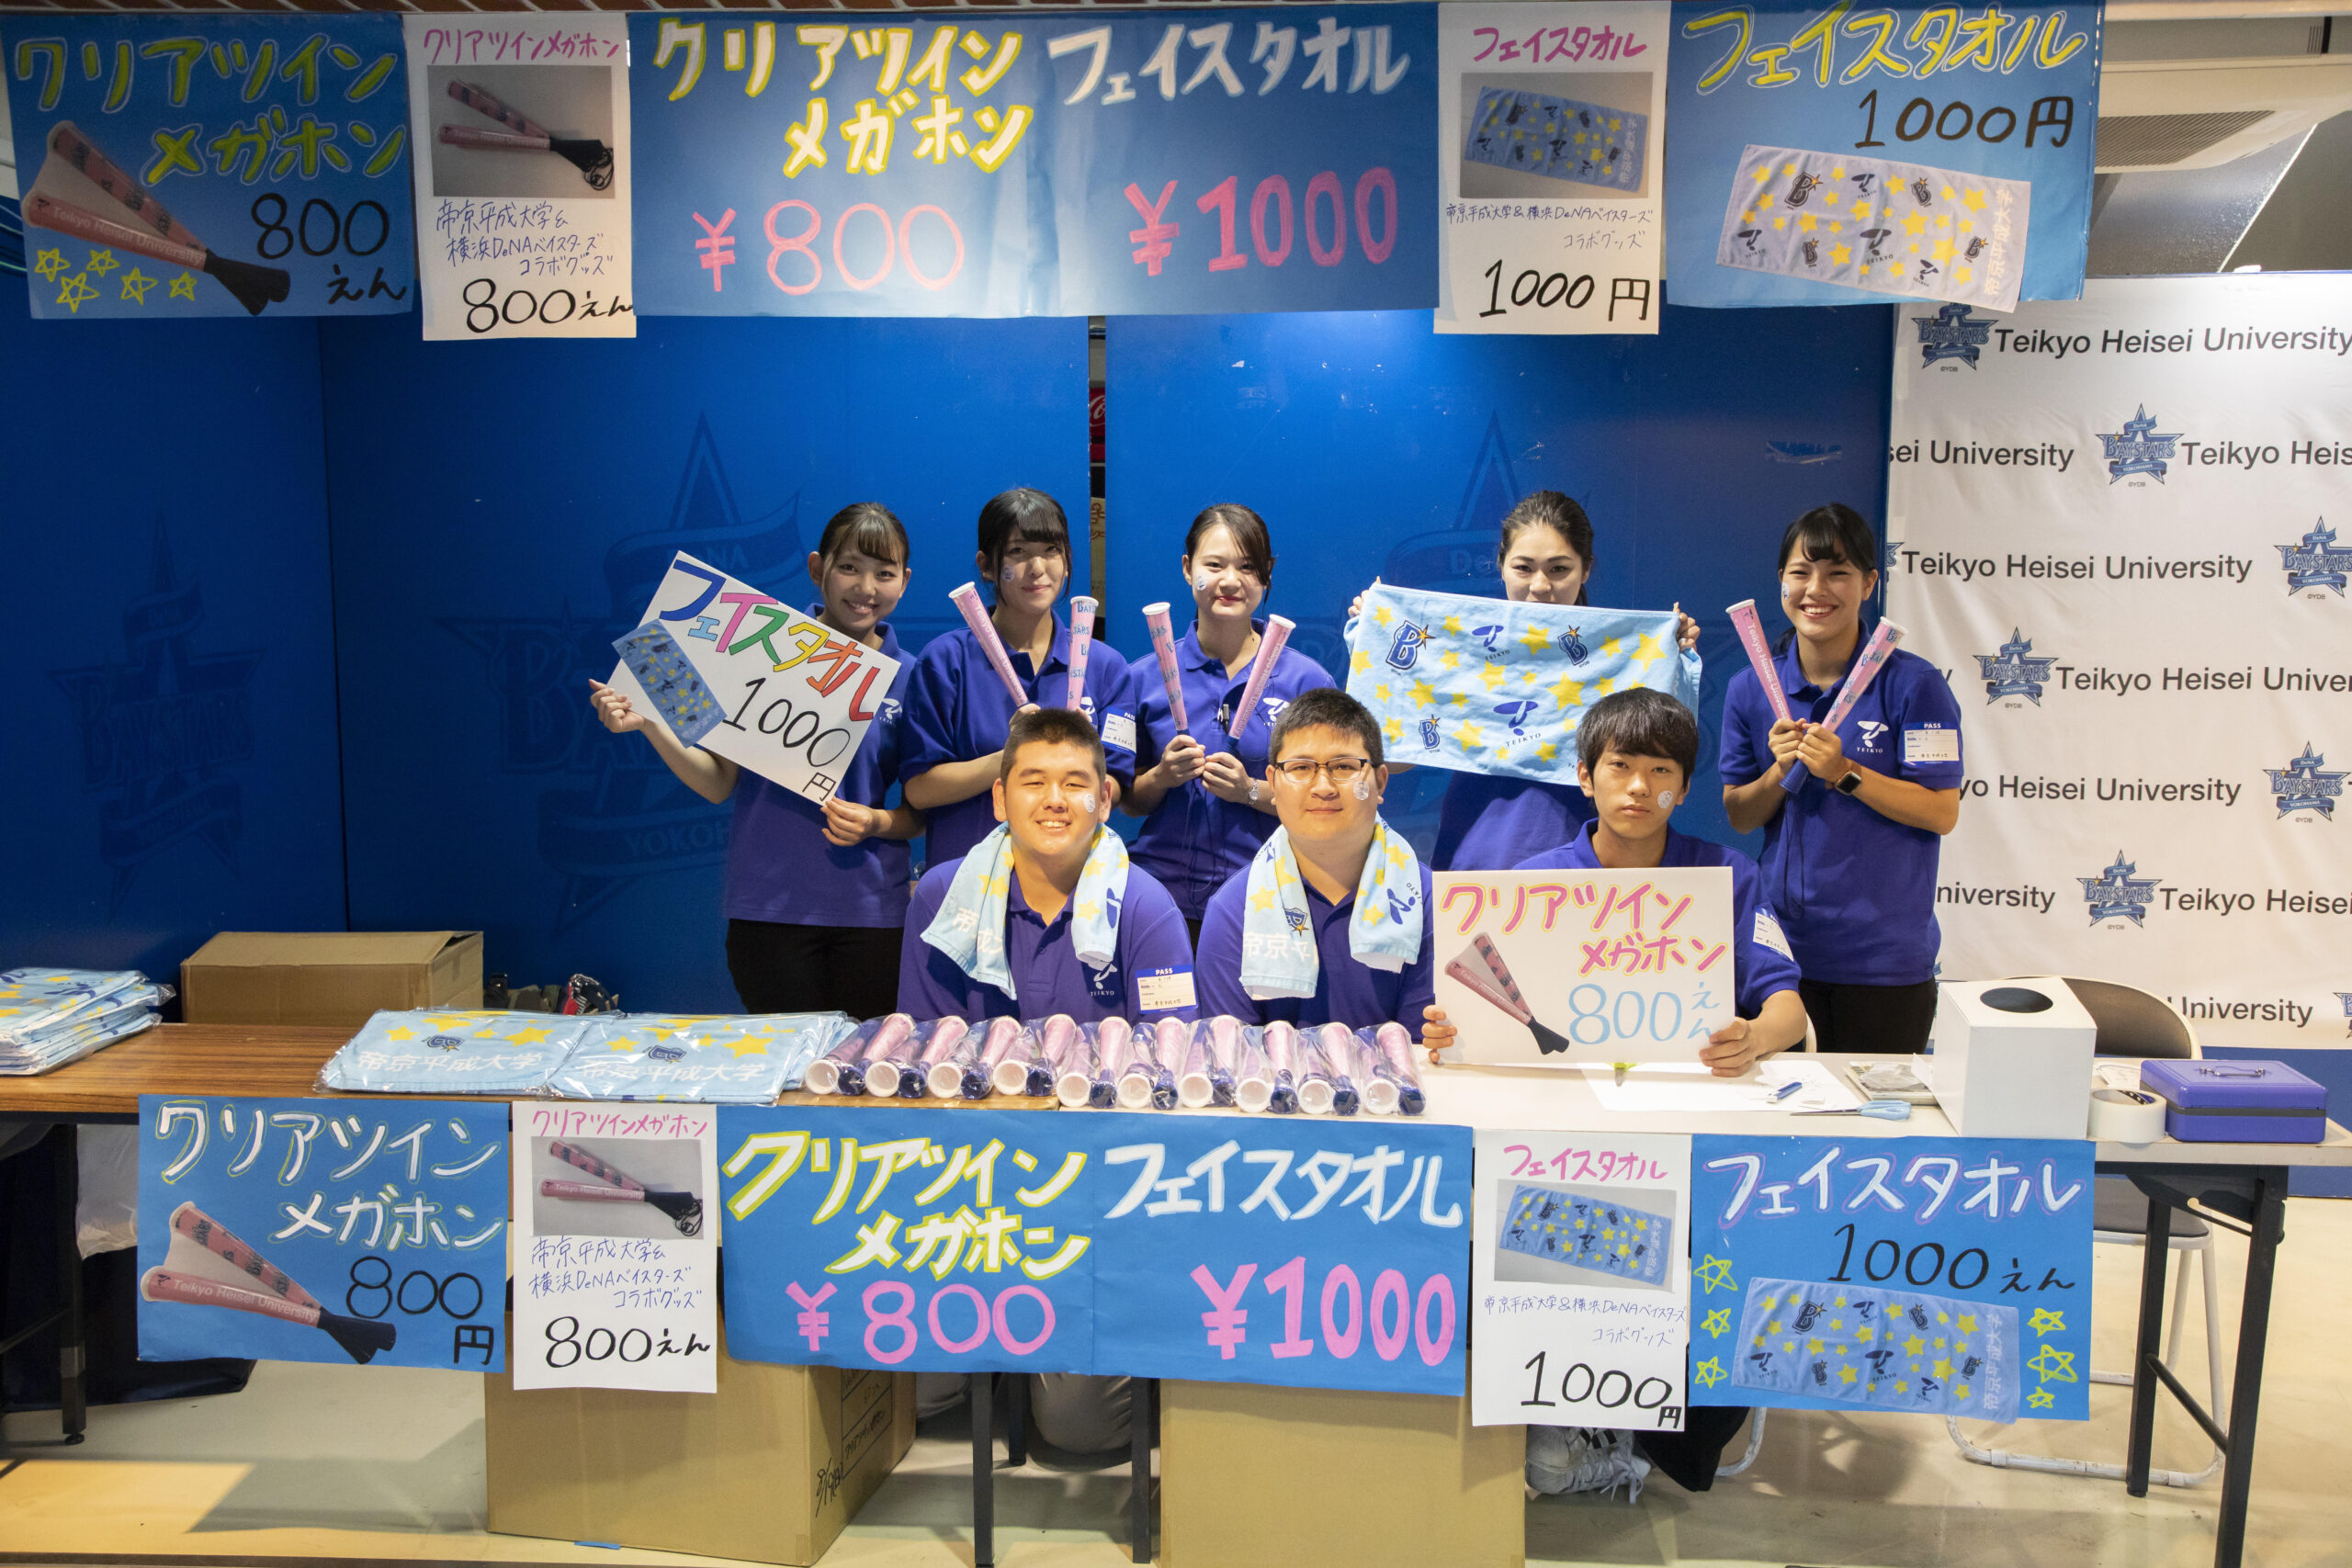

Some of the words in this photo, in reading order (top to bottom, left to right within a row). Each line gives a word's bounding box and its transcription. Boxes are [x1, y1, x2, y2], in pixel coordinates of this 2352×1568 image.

[424, 28, 619, 64] クリアツインメガホン
[653, 17, 1023, 101] クリアツイン
[1047, 17, 1410, 106] フェイスタオル
[1473, 26, 1647, 62] フェイスタオル
[1682, 0, 2088, 96] フェイスタオル
[15, 33, 397, 113] クリアツイン
[783, 87, 1034, 178] メガホン
[1855, 89, 2074, 148] 1000円
[140, 105, 406, 186] メガホン
[252, 193, 389, 259] 800
[328, 264, 406, 304] えん
[1918, 321, 1989, 344] BAYSTARS
[1995, 328, 2090, 359] Teikyo
[2102, 329, 2192, 354] Heisei
[2205, 325, 2352, 356] University
[1930, 440, 2074, 471] University
[2104, 436, 2176, 459] BAYSTARS
[2181, 442, 2279, 470] Teikyo
[1902, 551, 1996, 582] Teikyo
[2007, 553, 2095, 580] Heisei
[2106, 554, 2253, 583] University
[2283, 547, 2352, 570] BAYSTARS
[659, 559, 881, 722] フェイスタオル
[1485, 649, 1510, 661] TEIKYO
[1747, 623, 1763, 653] Teikyo
[1982, 658, 2051, 682] BAYSTARS
[2056, 667, 2151, 696] Teikyo
[2163, 666, 2252, 691] Heisei
[1506, 733, 1541, 747] TEIKYO
[1999, 775, 2086, 800] Heisei
[2097, 777, 2242, 807] University
[2271, 772, 2343, 795] BAYSTARS
[1441, 882, 1693, 935] クリアツイン
[2084, 881, 2154, 903] BAYSTARS
[2160, 888, 2255, 917] Teikyo
[1577, 931, 1727, 977] メガホン
[1568, 983, 1683, 1045] 800
[356, 1051, 544, 1074] 帝京平成大学
[533, 1109, 707, 1137] クリアツインメガホン
[156, 1100, 501, 1185] クリアツイン
[721, 1131, 1088, 1224] クリアツイン
[1504, 1145, 1668, 1182] フェイスタオル
[1104, 1139, 1463, 1227] フェイスタオル
[1703, 1144, 2086, 1229] フェイスタオル
[268, 1184, 503, 1251] メガホン
[824, 1205, 1091, 1281] メガホン
[174, 1279, 213, 1296] Teikyo
[258, 1292, 318, 1323] University
[346, 1256, 483, 1319] 800
[613, 1287, 702, 1309] コラボグッズ
[454, 1325, 494, 1365] 円
